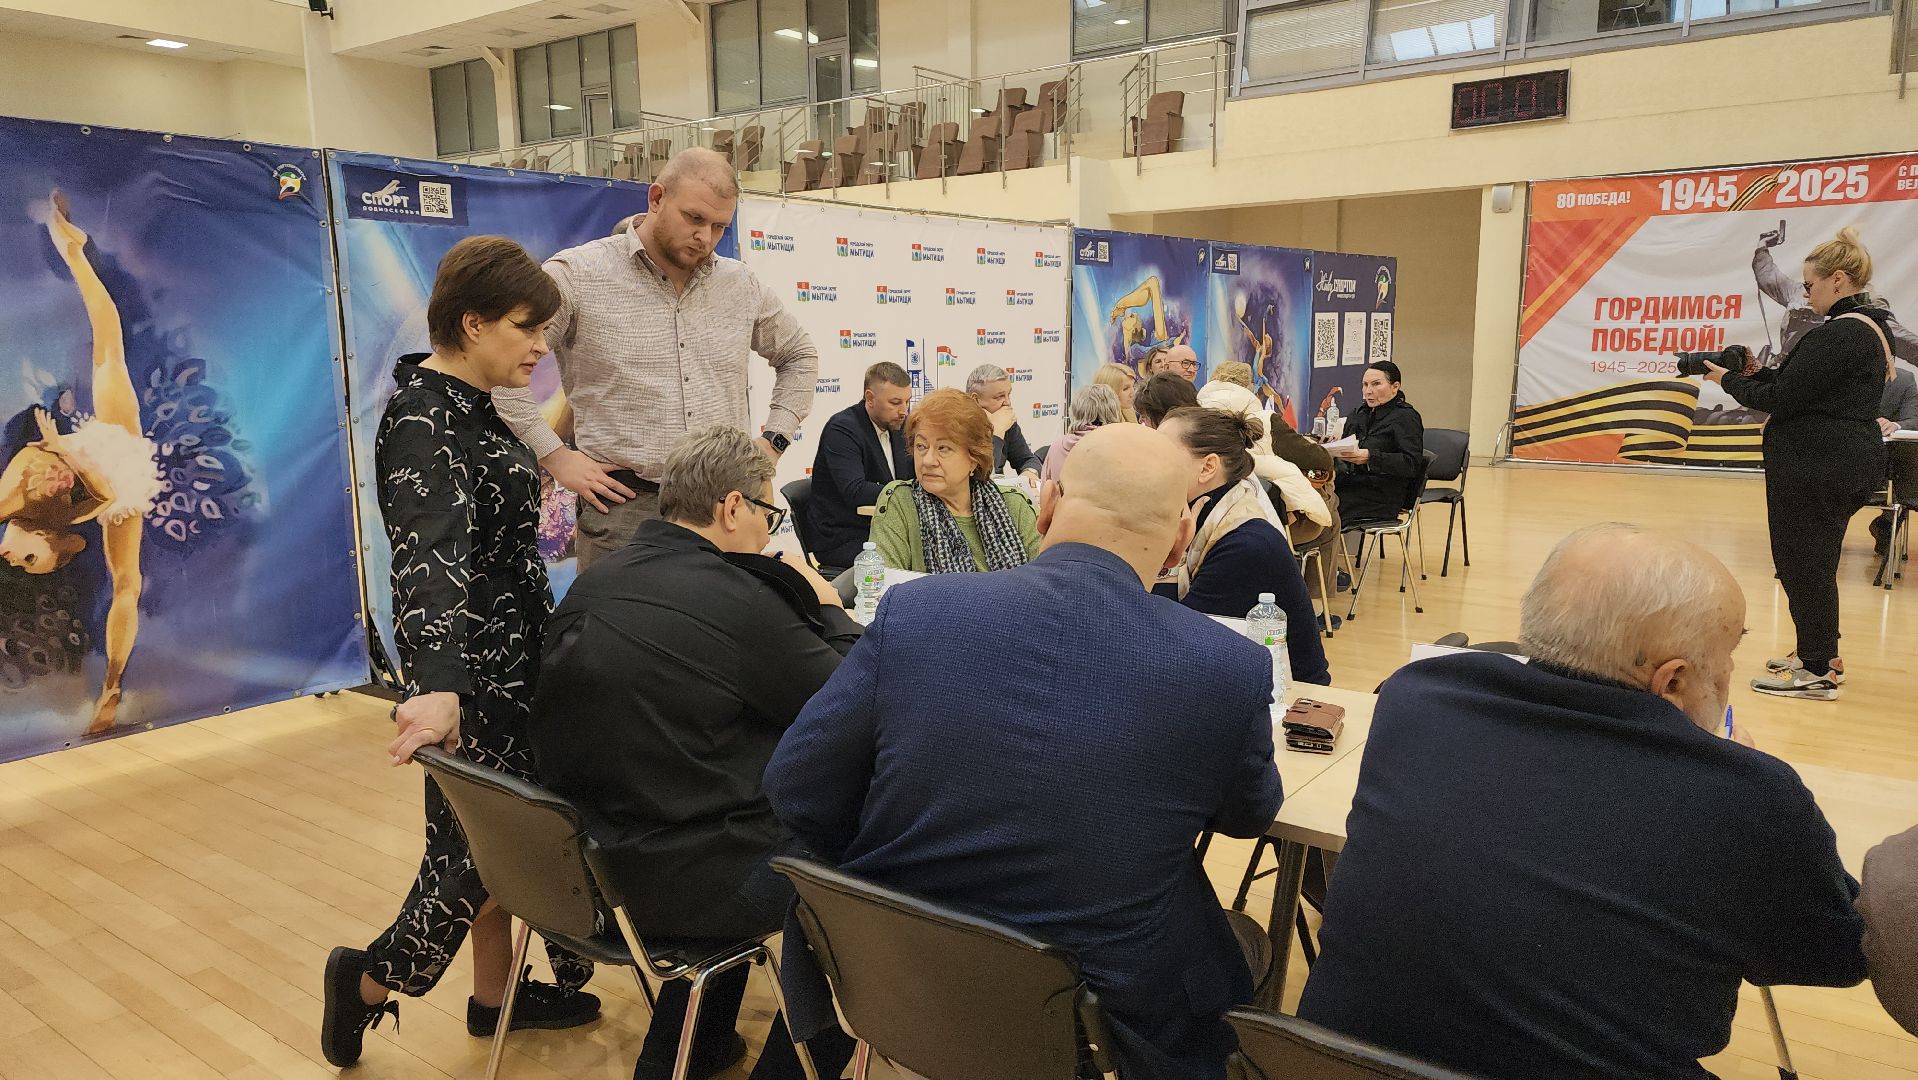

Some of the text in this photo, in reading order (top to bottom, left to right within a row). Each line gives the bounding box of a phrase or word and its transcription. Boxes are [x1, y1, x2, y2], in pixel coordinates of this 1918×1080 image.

[1898, 165, 1908, 177] С
[1658, 164, 1869, 211] 1945 2025
[361, 192, 410, 208] СПОРТ
[1556, 191, 1631, 210] 80 ПОБЕДА!
[767, 242, 795, 253] МЫТИЩИ
[850, 248, 875, 258] МЫТИЩИ
[811, 292, 837, 302] МЫТИЩИ
[1594, 294, 1743, 325] ГОРДИМСЯ
[852, 339, 877, 348] МЫТИЩИ
[1591, 324, 1725, 355] ПОБЕДОЙ!
